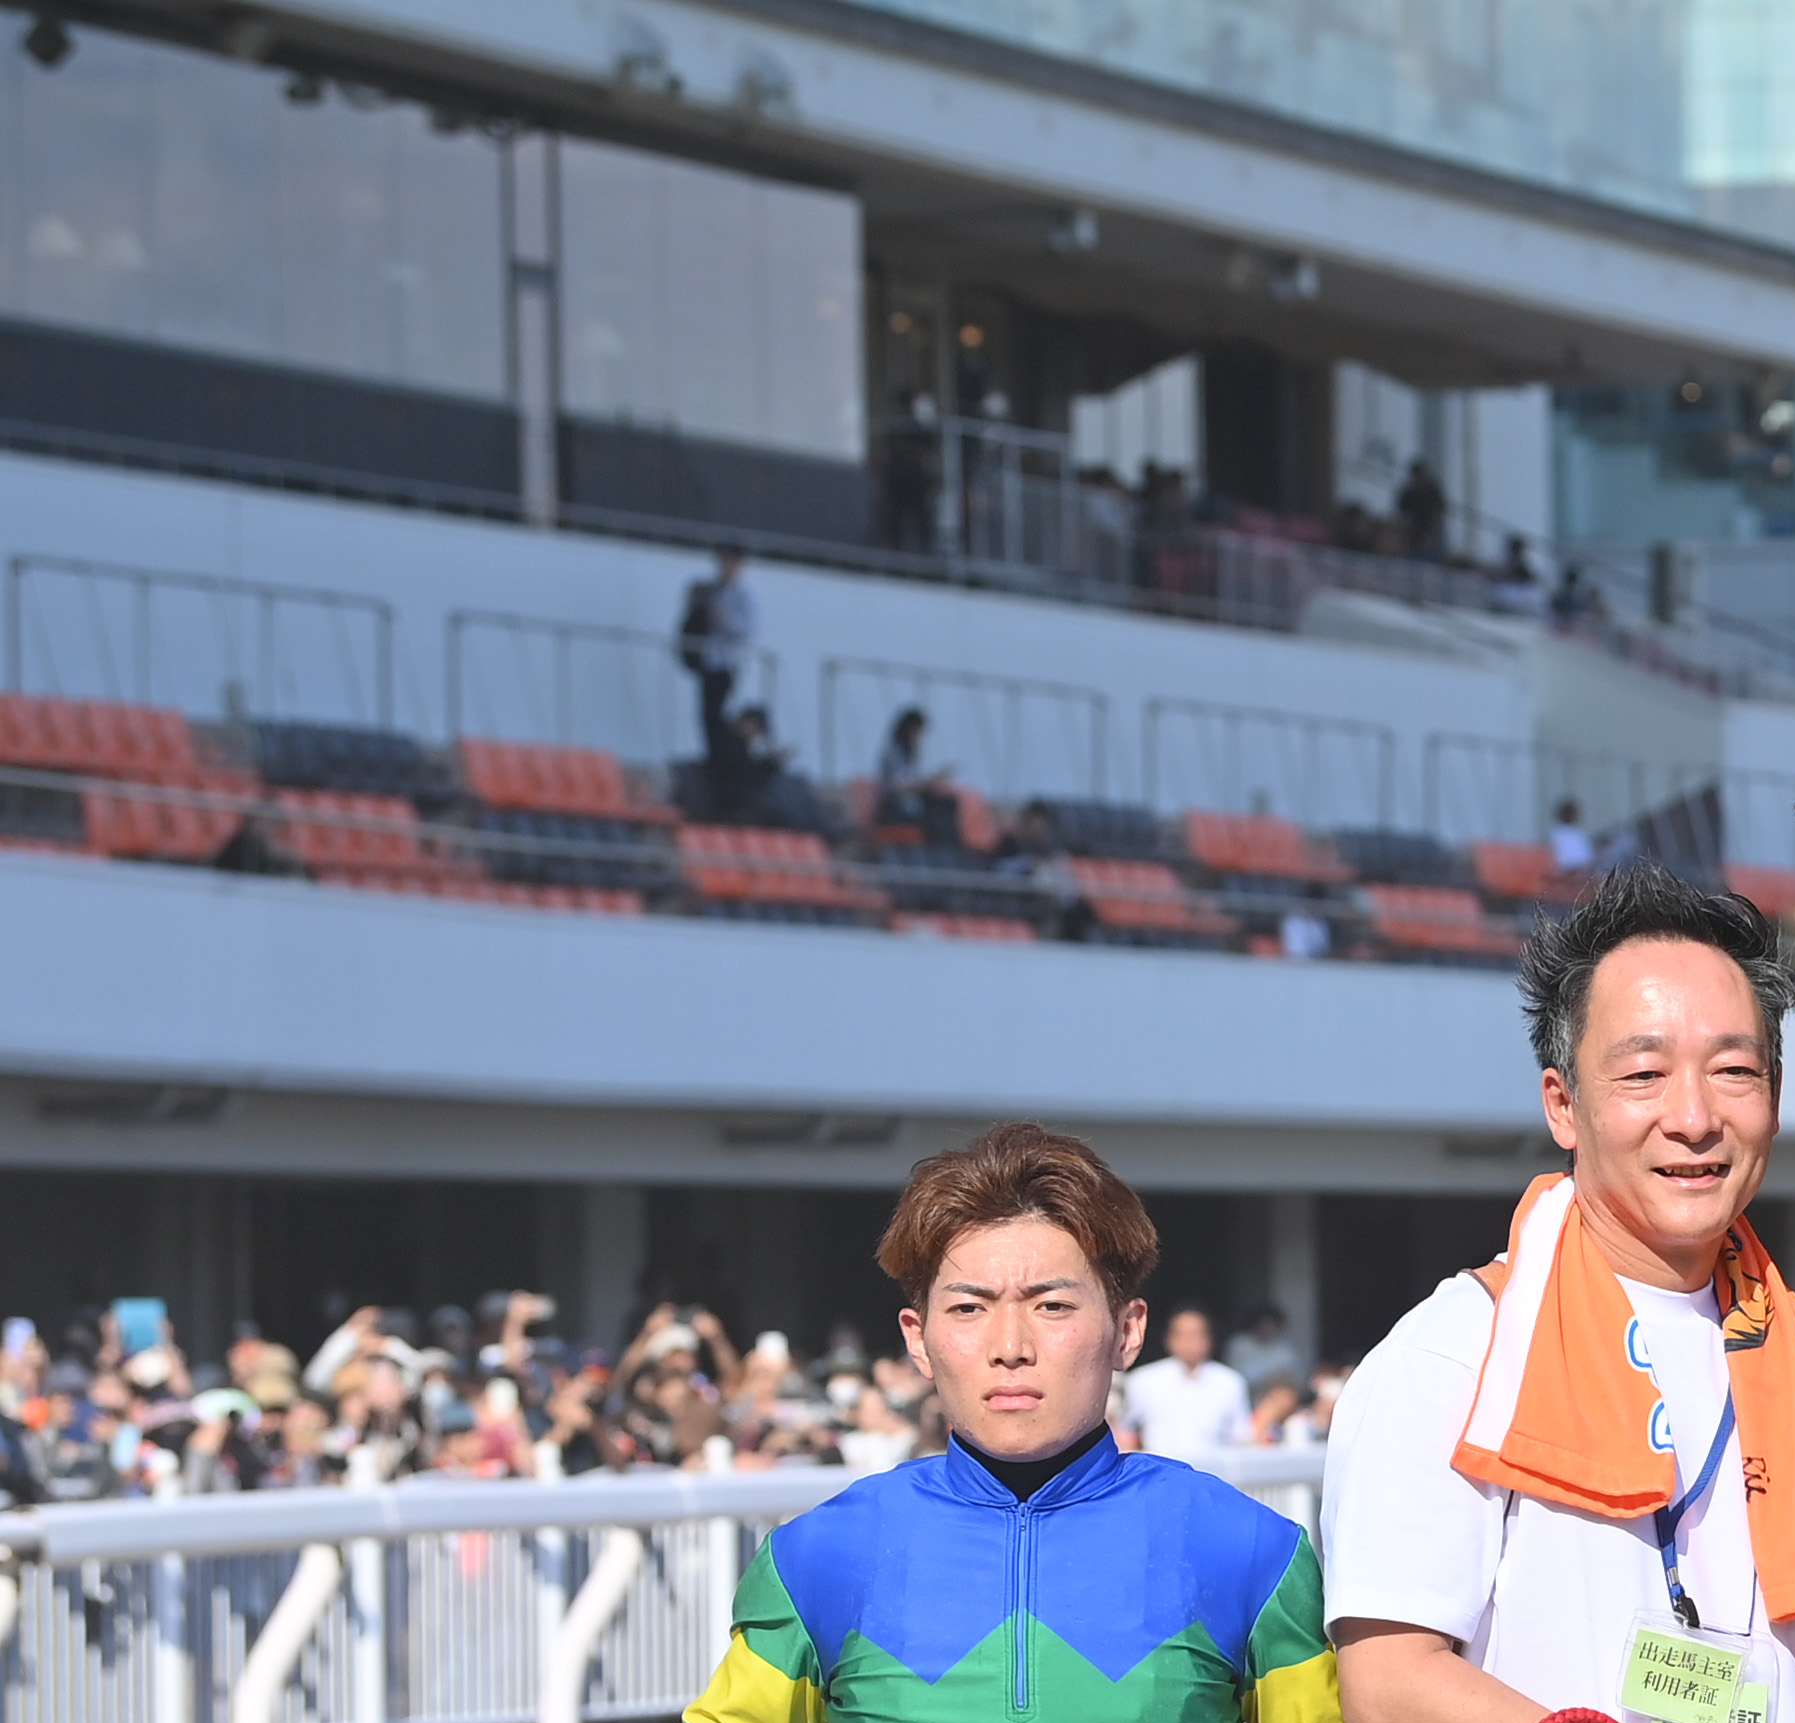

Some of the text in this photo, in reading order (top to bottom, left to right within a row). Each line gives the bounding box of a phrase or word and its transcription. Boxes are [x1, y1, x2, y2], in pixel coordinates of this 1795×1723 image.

[1638, 1641, 1735, 1682] 出走馬主室
[1643, 1670, 1720, 1707] 利用者証
